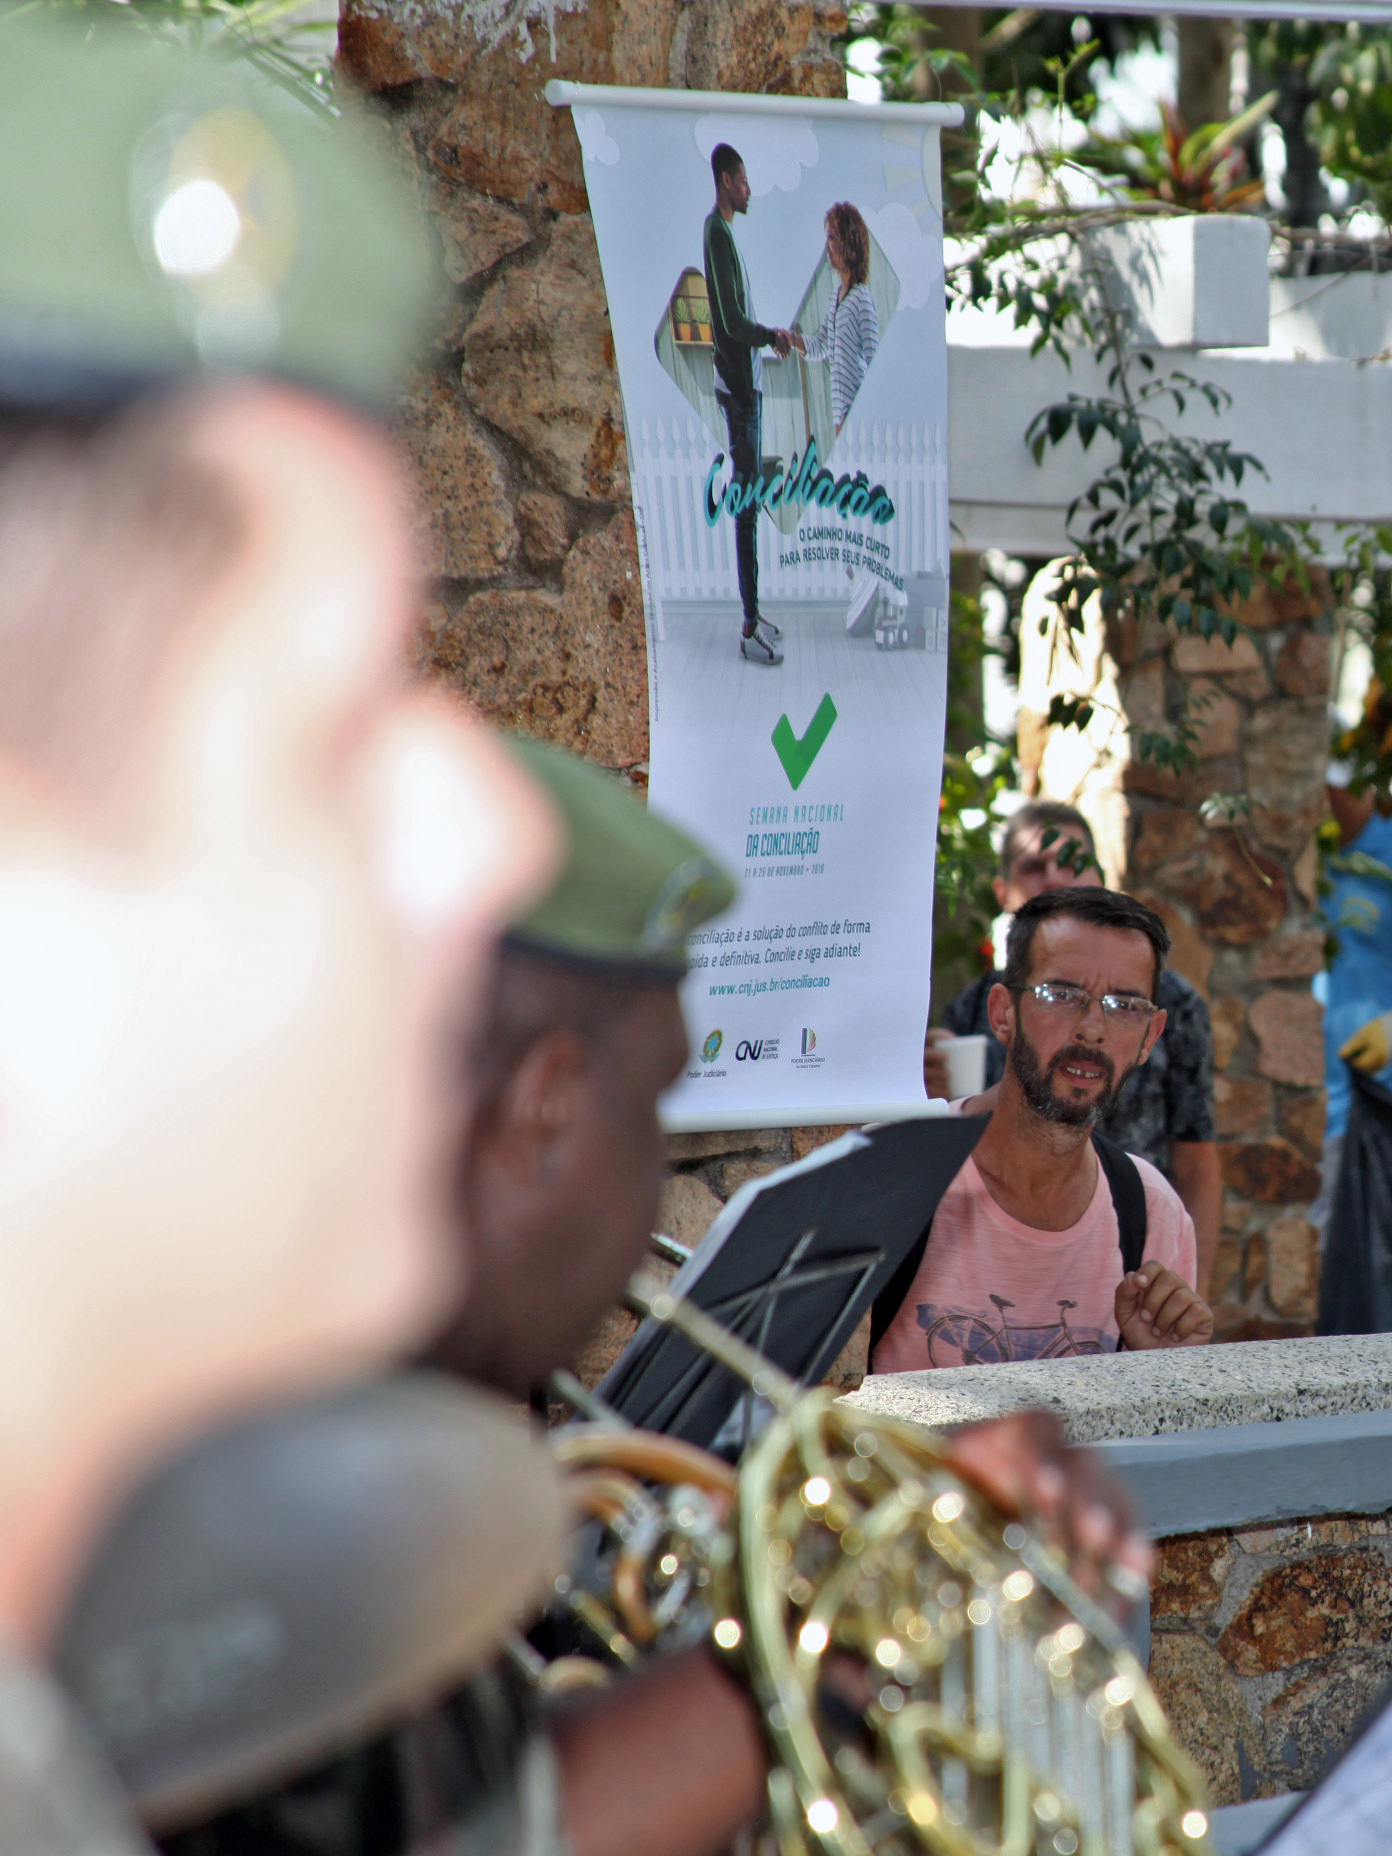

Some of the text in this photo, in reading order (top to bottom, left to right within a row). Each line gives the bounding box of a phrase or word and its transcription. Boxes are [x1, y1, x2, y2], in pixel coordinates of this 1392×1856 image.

[703, 435, 895, 527] Conciliação
[799, 526, 890, 560] O CAMINHO MAIS CURTO
[780, 551, 800, 568] PARA
[803, 547, 839, 562] RESOLVER
[842, 548, 860, 566] SEUS
[749, 803, 844, 825] SEMANA NACIONAL
[745, 827, 820, 860] DA CONCILIAÇÃO
[737, 926, 743, 942] é
[744, 930, 750, 941] a
[752, 925, 784, 943] solução
[785, 924, 796, 939] do
[798, 921, 828, 937] conflito
[830, 920, 841, 934] de
[843, 919, 871, 934] forma
[711, 956, 718, 967] e
[719, 950, 761, 967] definitiva.
[764, 948, 796, 963] Concilie
[797, 950, 803, 961] e
[804, 945, 821, 964] siga
[823, 942, 861, 959] adiante!
[709, 974, 831, 997] www.cnj.jus.br/conciliacao
